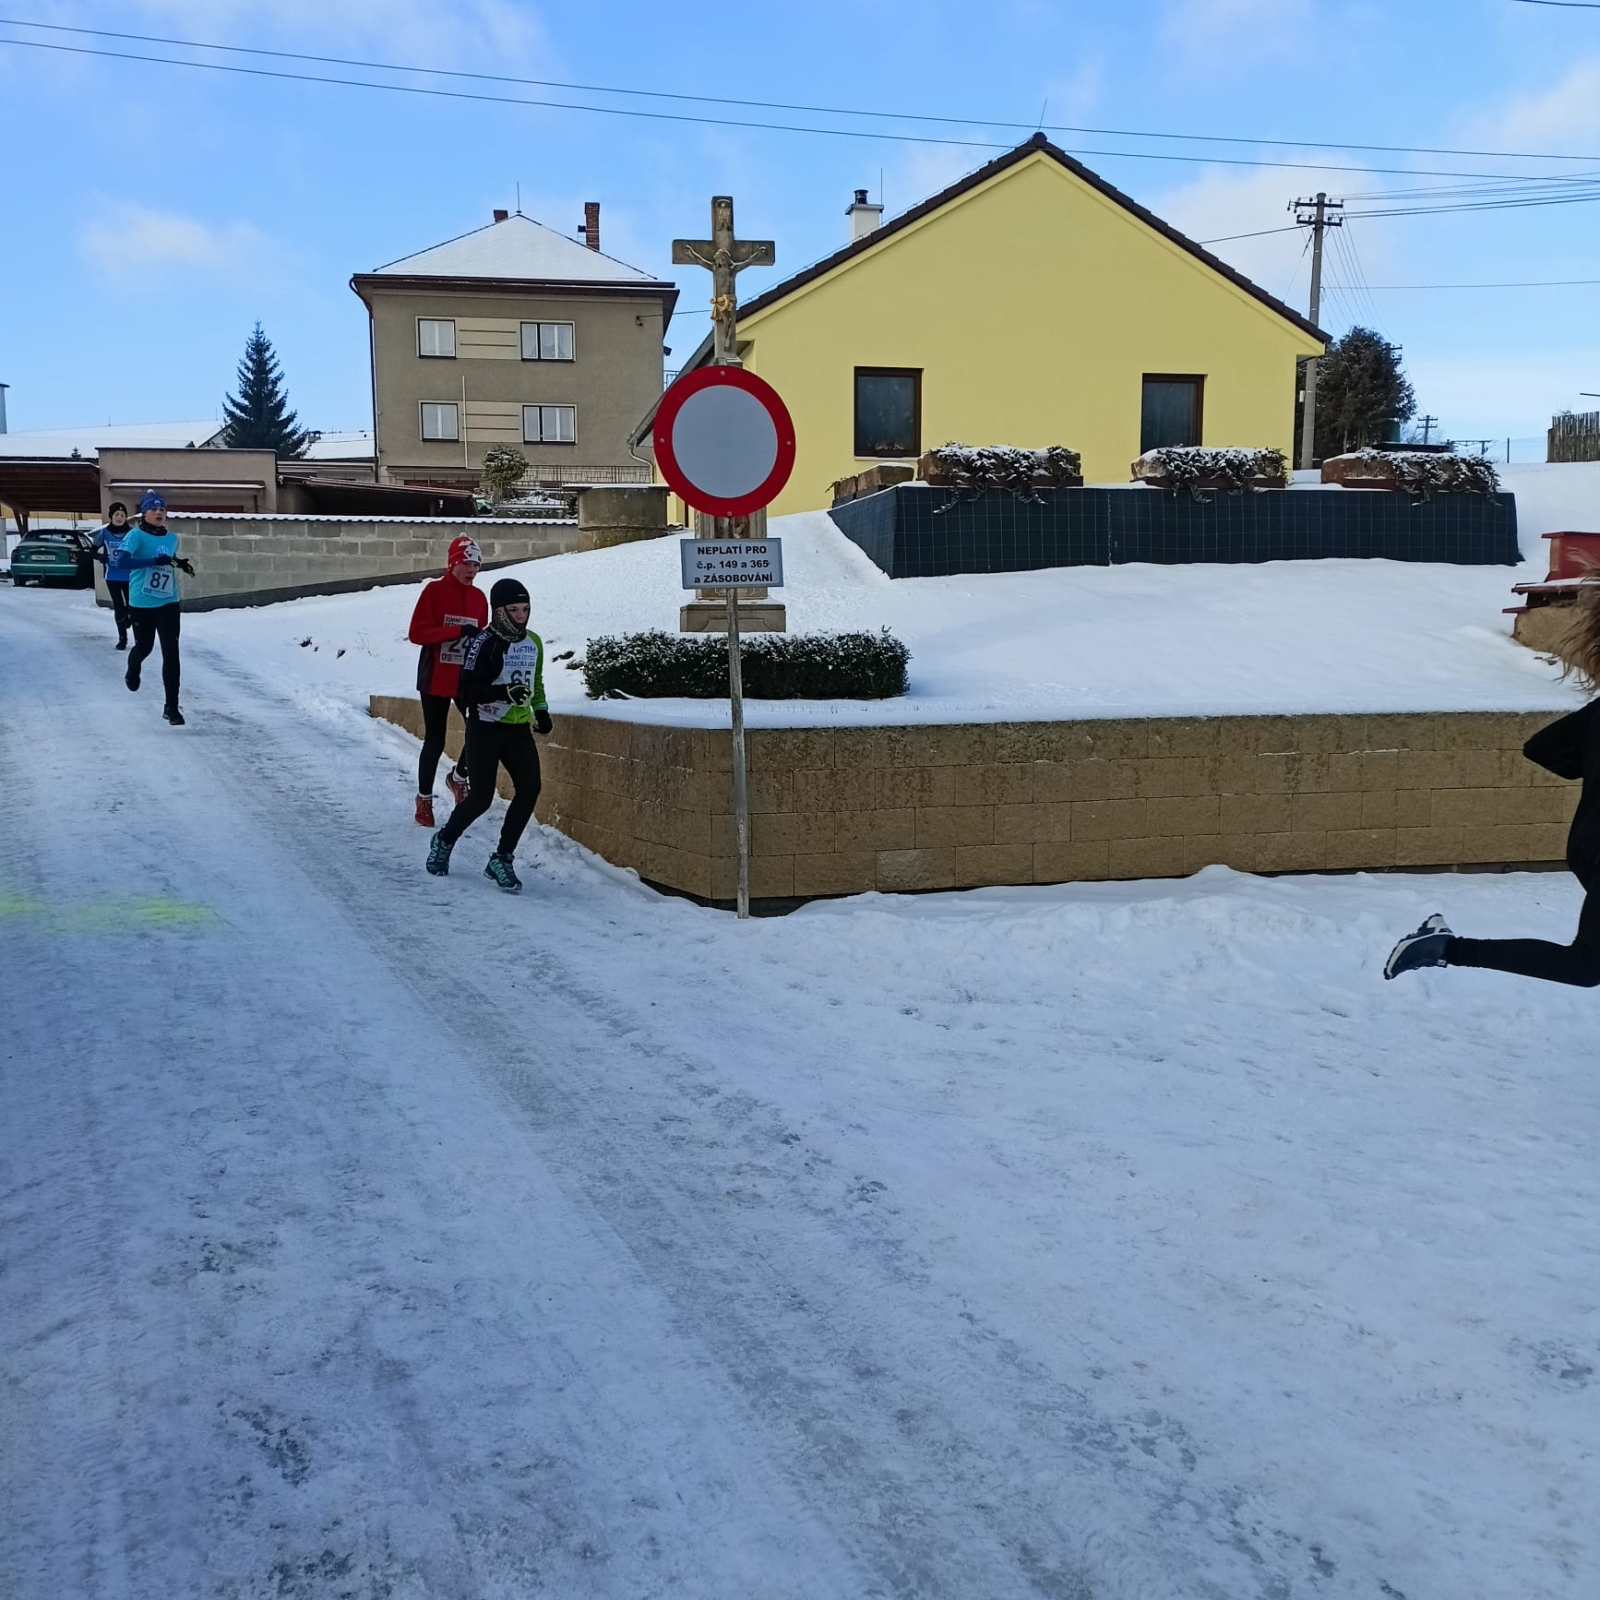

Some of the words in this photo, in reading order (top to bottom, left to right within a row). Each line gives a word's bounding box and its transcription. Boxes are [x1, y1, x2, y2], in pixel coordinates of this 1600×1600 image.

[697, 544, 742, 555] NEPLATÍ
[745, 545, 767, 554] PRO
[696, 560, 716, 570] č.p.
[719, 560, 738, 569] 149
[750, 559, 769, 568] 365
[150, 571, 170, 590] 87
[703, 572, 773, 583] ZÁSOBOVÁNÍ
